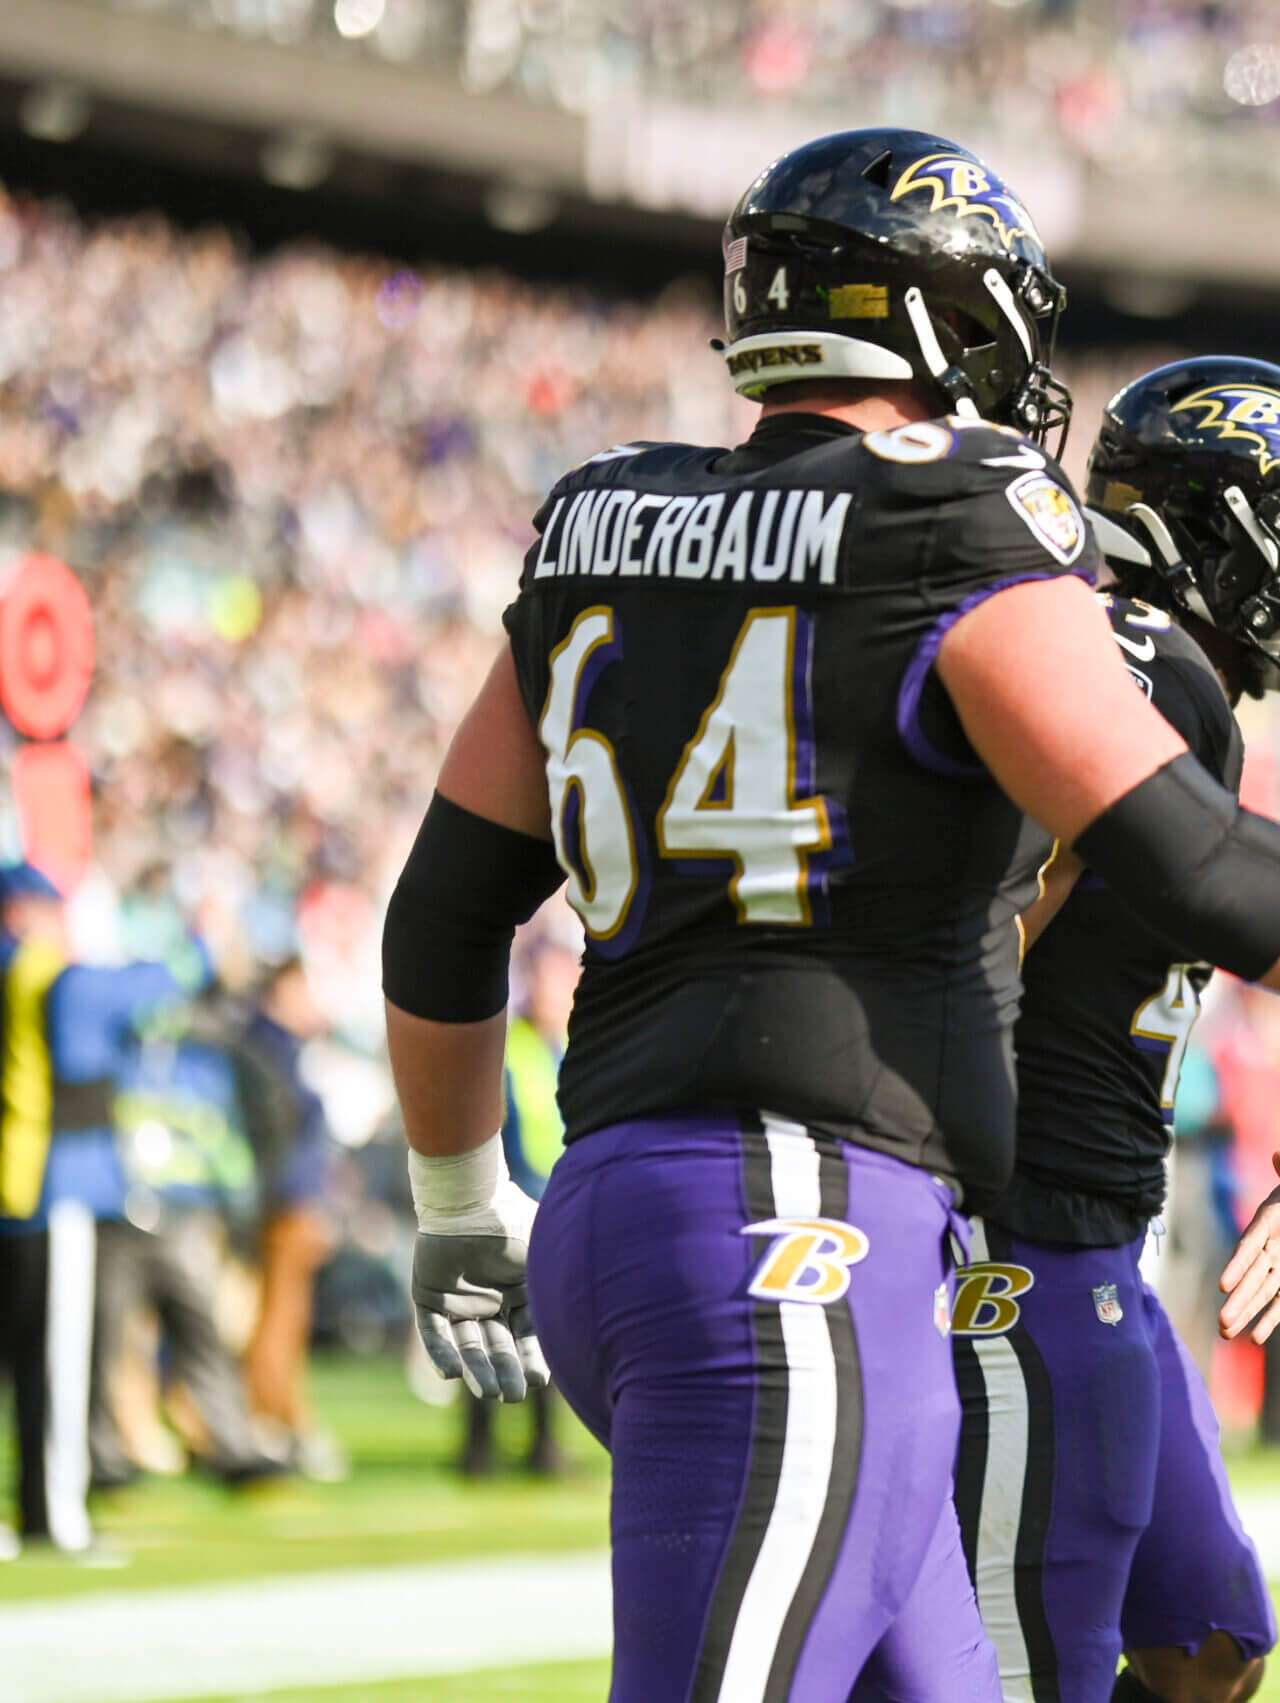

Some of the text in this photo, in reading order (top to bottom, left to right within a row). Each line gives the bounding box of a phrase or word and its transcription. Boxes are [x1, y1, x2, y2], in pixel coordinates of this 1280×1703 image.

[534, 487, 853, 585] LINDERBAUM
[539, 604, 848, 948] 64
[740, 1217, 869, 1304] B
[953, 1263, 1034, 1336] B
